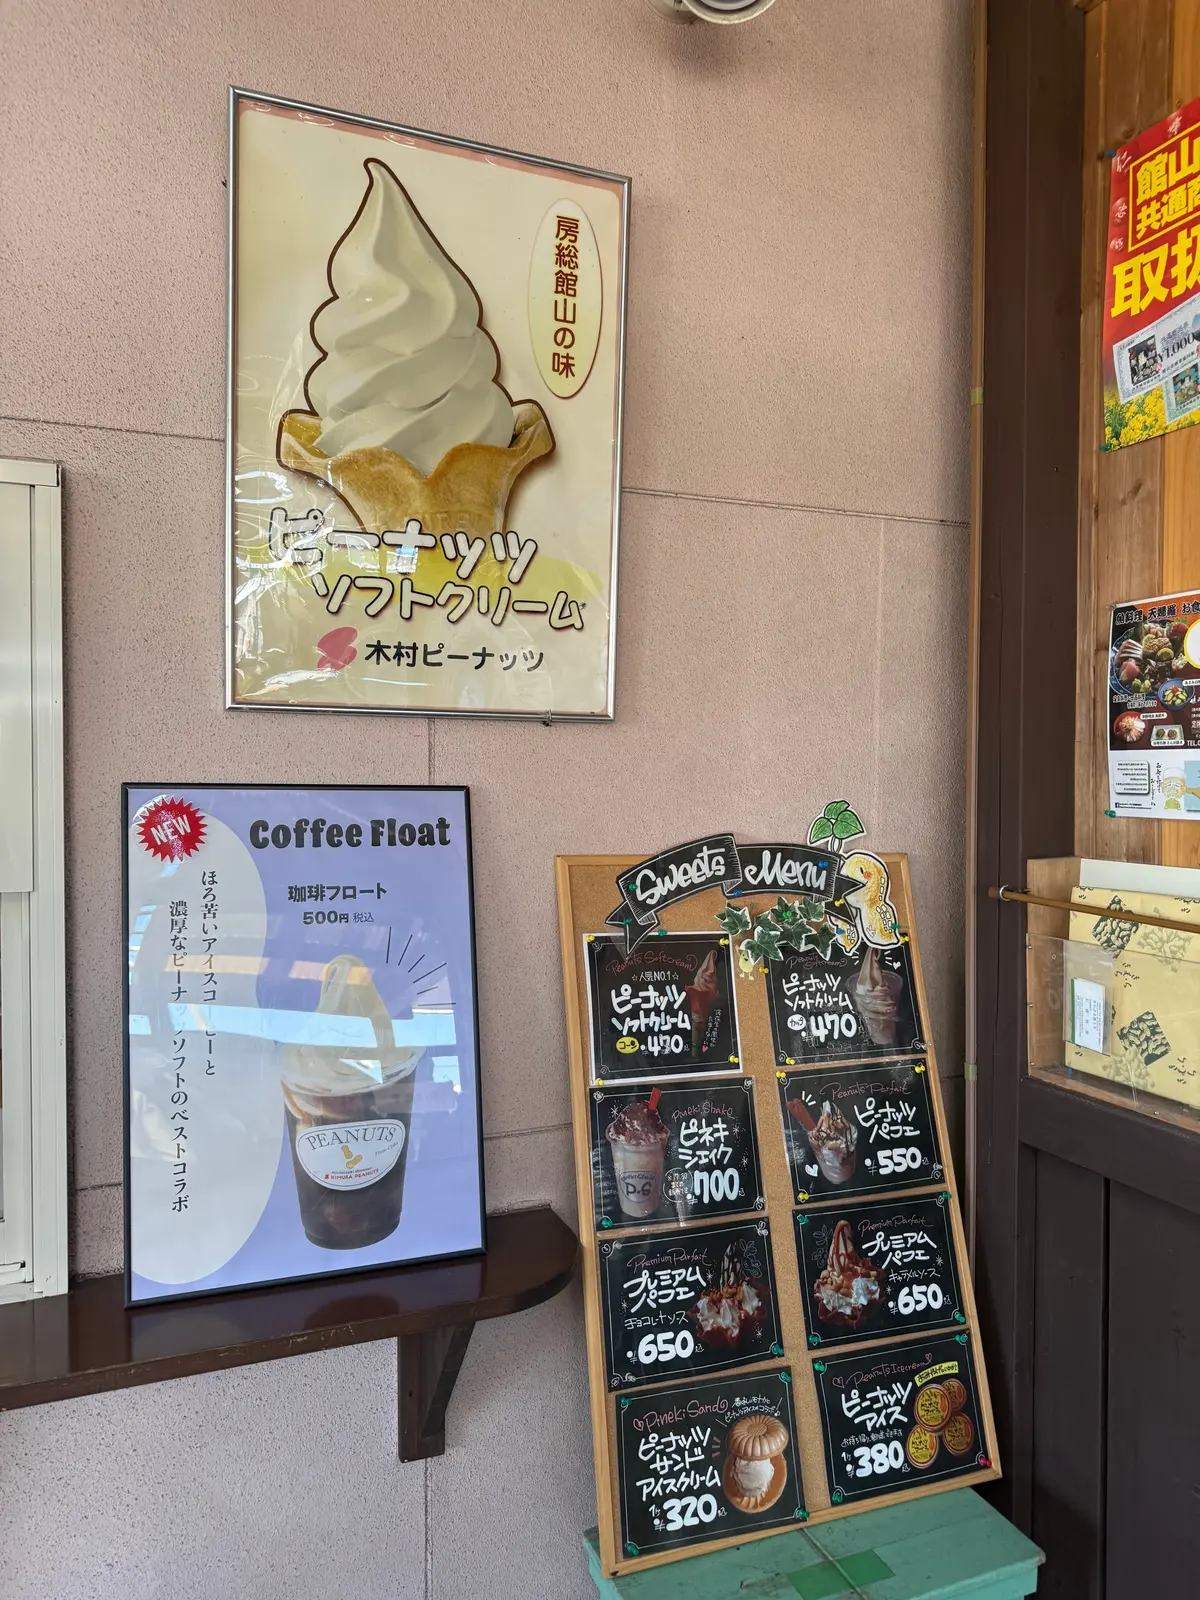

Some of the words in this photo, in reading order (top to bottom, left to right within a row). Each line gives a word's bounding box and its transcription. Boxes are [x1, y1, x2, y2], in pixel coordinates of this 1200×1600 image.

[552, 215, 580, 378] 房総館山の味
[268, 507, 538, 584] ピーナッツ
[311, 573, 586, 631] ソフトクリーム
[365, 640, 545, 672] 木村ピーナッツ
[150, 813, 191, 846] NEW
[250, 818, 363, 849] Coffee
[371, 817, 451, 847] Float
[635, 846, 725, 904] Sweets
[744, 850, 827, 891] Menu
[288, 882, 387, 904] 珈琲フロート
[303, 911, 349, 926] 500円
[352, 911, 375, 924] 税込
[782, 972, 841, 995] ピーナッツ
[611, 984, 686, 1014] ピーナッツ
[784, 991, 853, 1011] ソフトクリーム
[611, 1009, 691, 1036] ソフトクリーム
[853, 1097, 916, 1127] ピーナッツ
[306, 1126, 397, 1150] PEANUTS
[680, 1117, 730, 1147] ピネキ
[869, 1122, 921, 1144] パフェ
[678, 1143, 733, 1169] シェイク
[861, 1231, 938, 1256] プレミアム
[881, 1250, 930, 1270] パフェ
[623, 1266, 707, 1298] プレミアム
[888, 1268, 941, 1283] キャラメルソース
[630, 1287, 695, 1313] パフェ
[624, 1310, 689, 1330] チョコレートソース
[841, 1381, 913, 1418] ピーナッツ
[643, 1410, 686, 1433] Pineki
[853, 1405, 908, 1432] アイス
[638, 1425, 711, 1461] ピーナッツ
[650, 1446, 705, 1475] サンド
[635, 1465, 722, 1501] アイスクリーム
